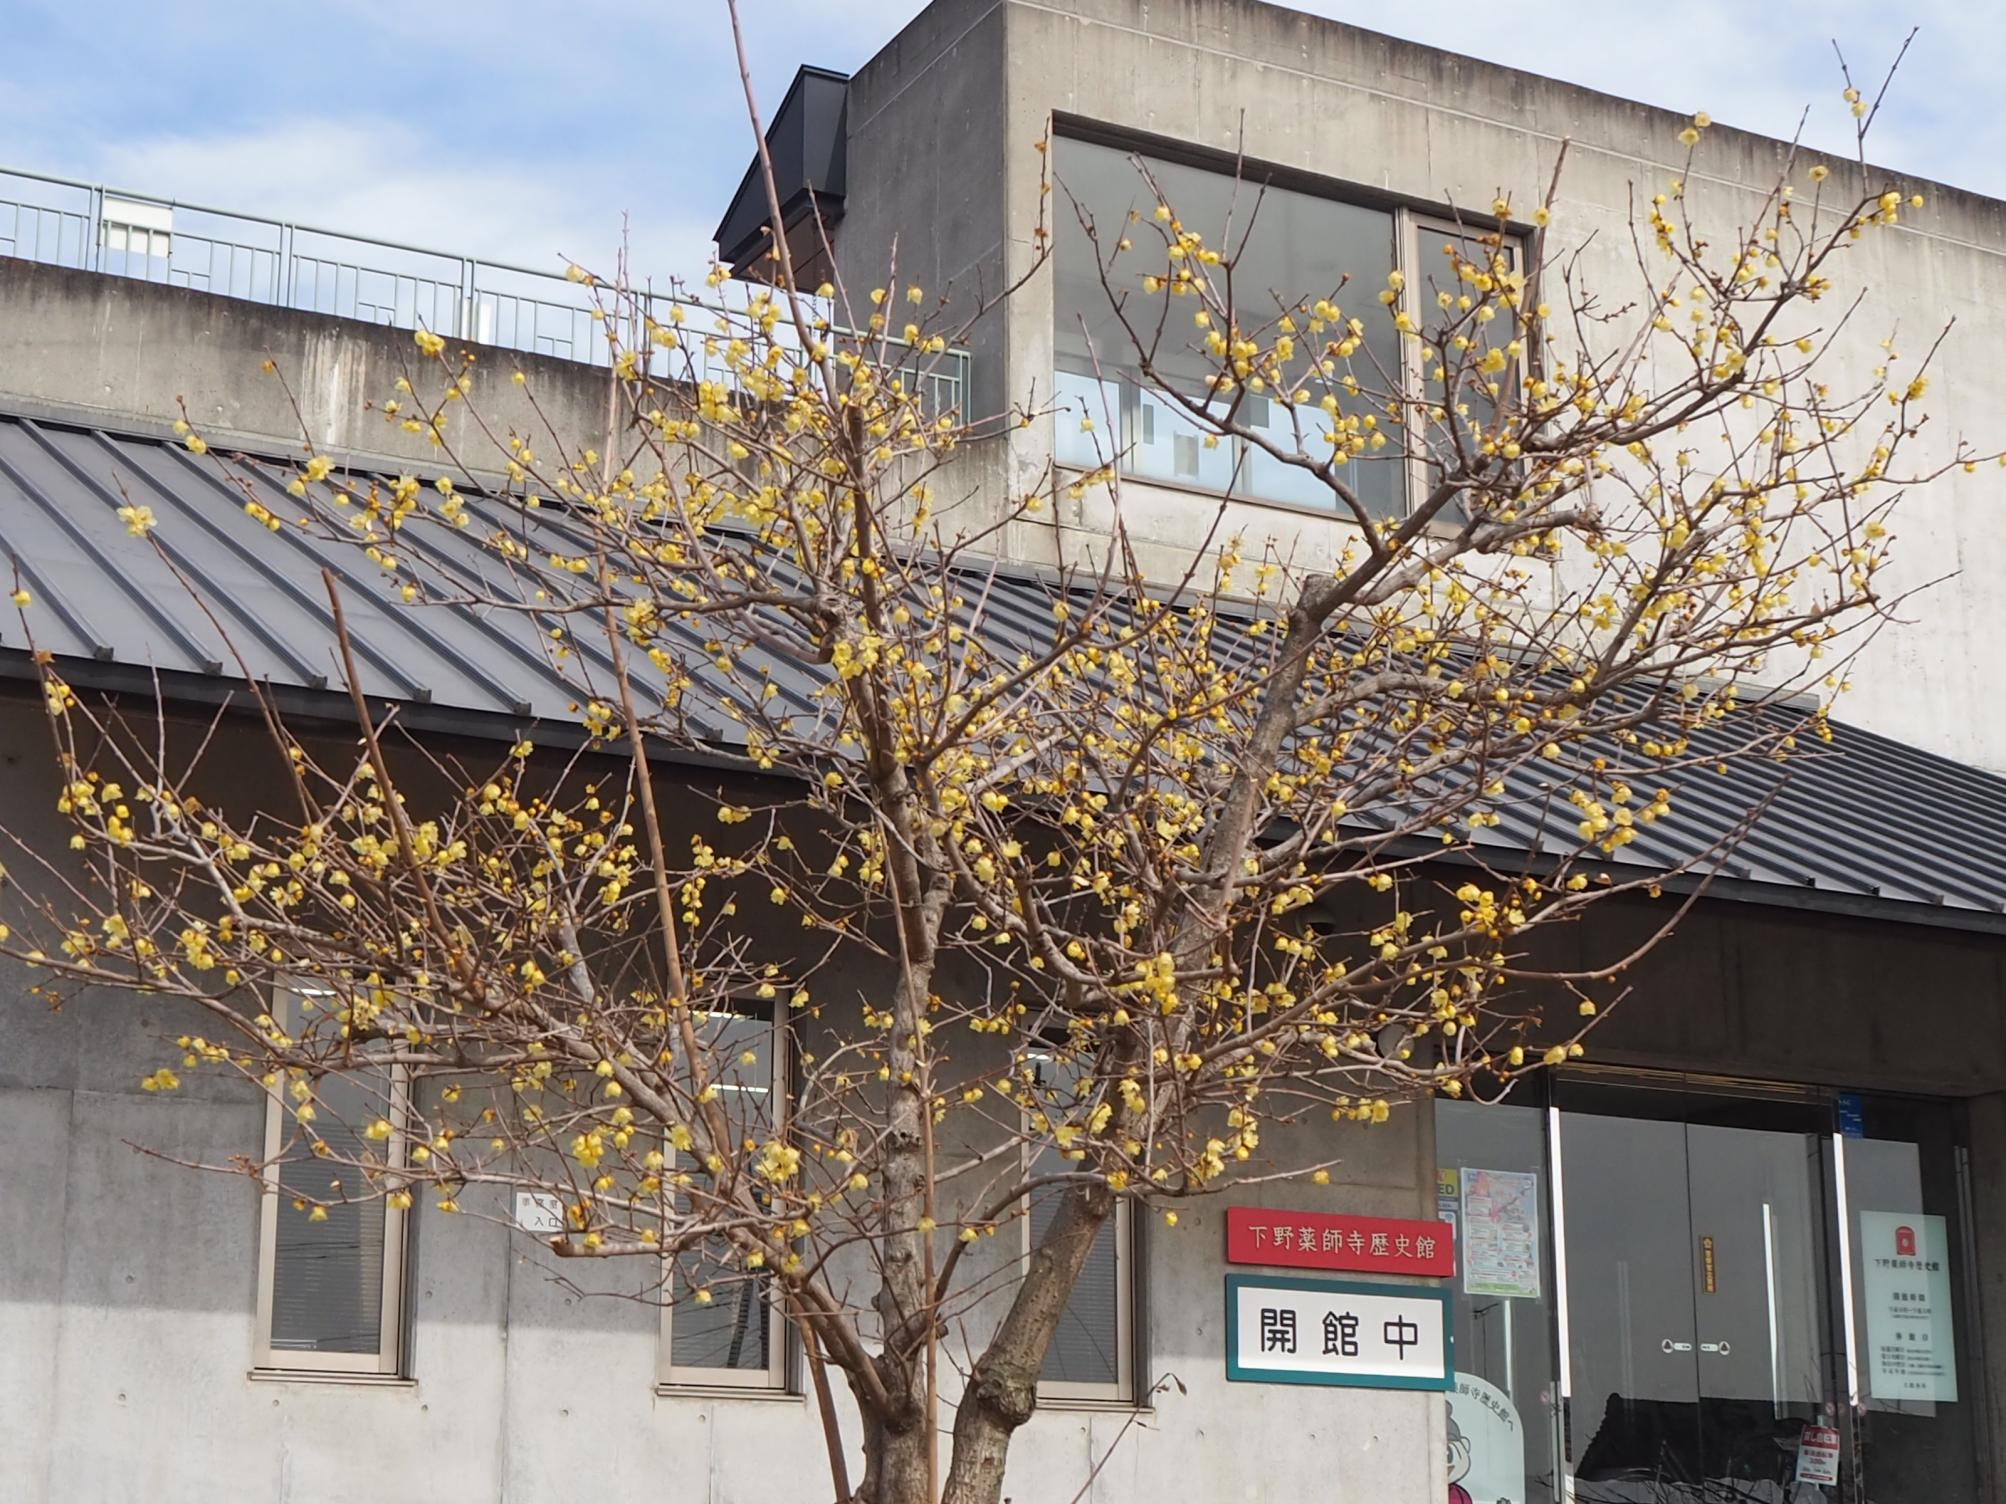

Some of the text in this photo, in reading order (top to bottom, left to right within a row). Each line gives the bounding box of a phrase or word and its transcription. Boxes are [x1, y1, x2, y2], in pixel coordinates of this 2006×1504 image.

[534, 1216, 558, 1227] 入口
[1248, 1225, 1436, 1259] 下野薬師寺歴史館
[1260, 1307, 1418, 1361] 開館中
